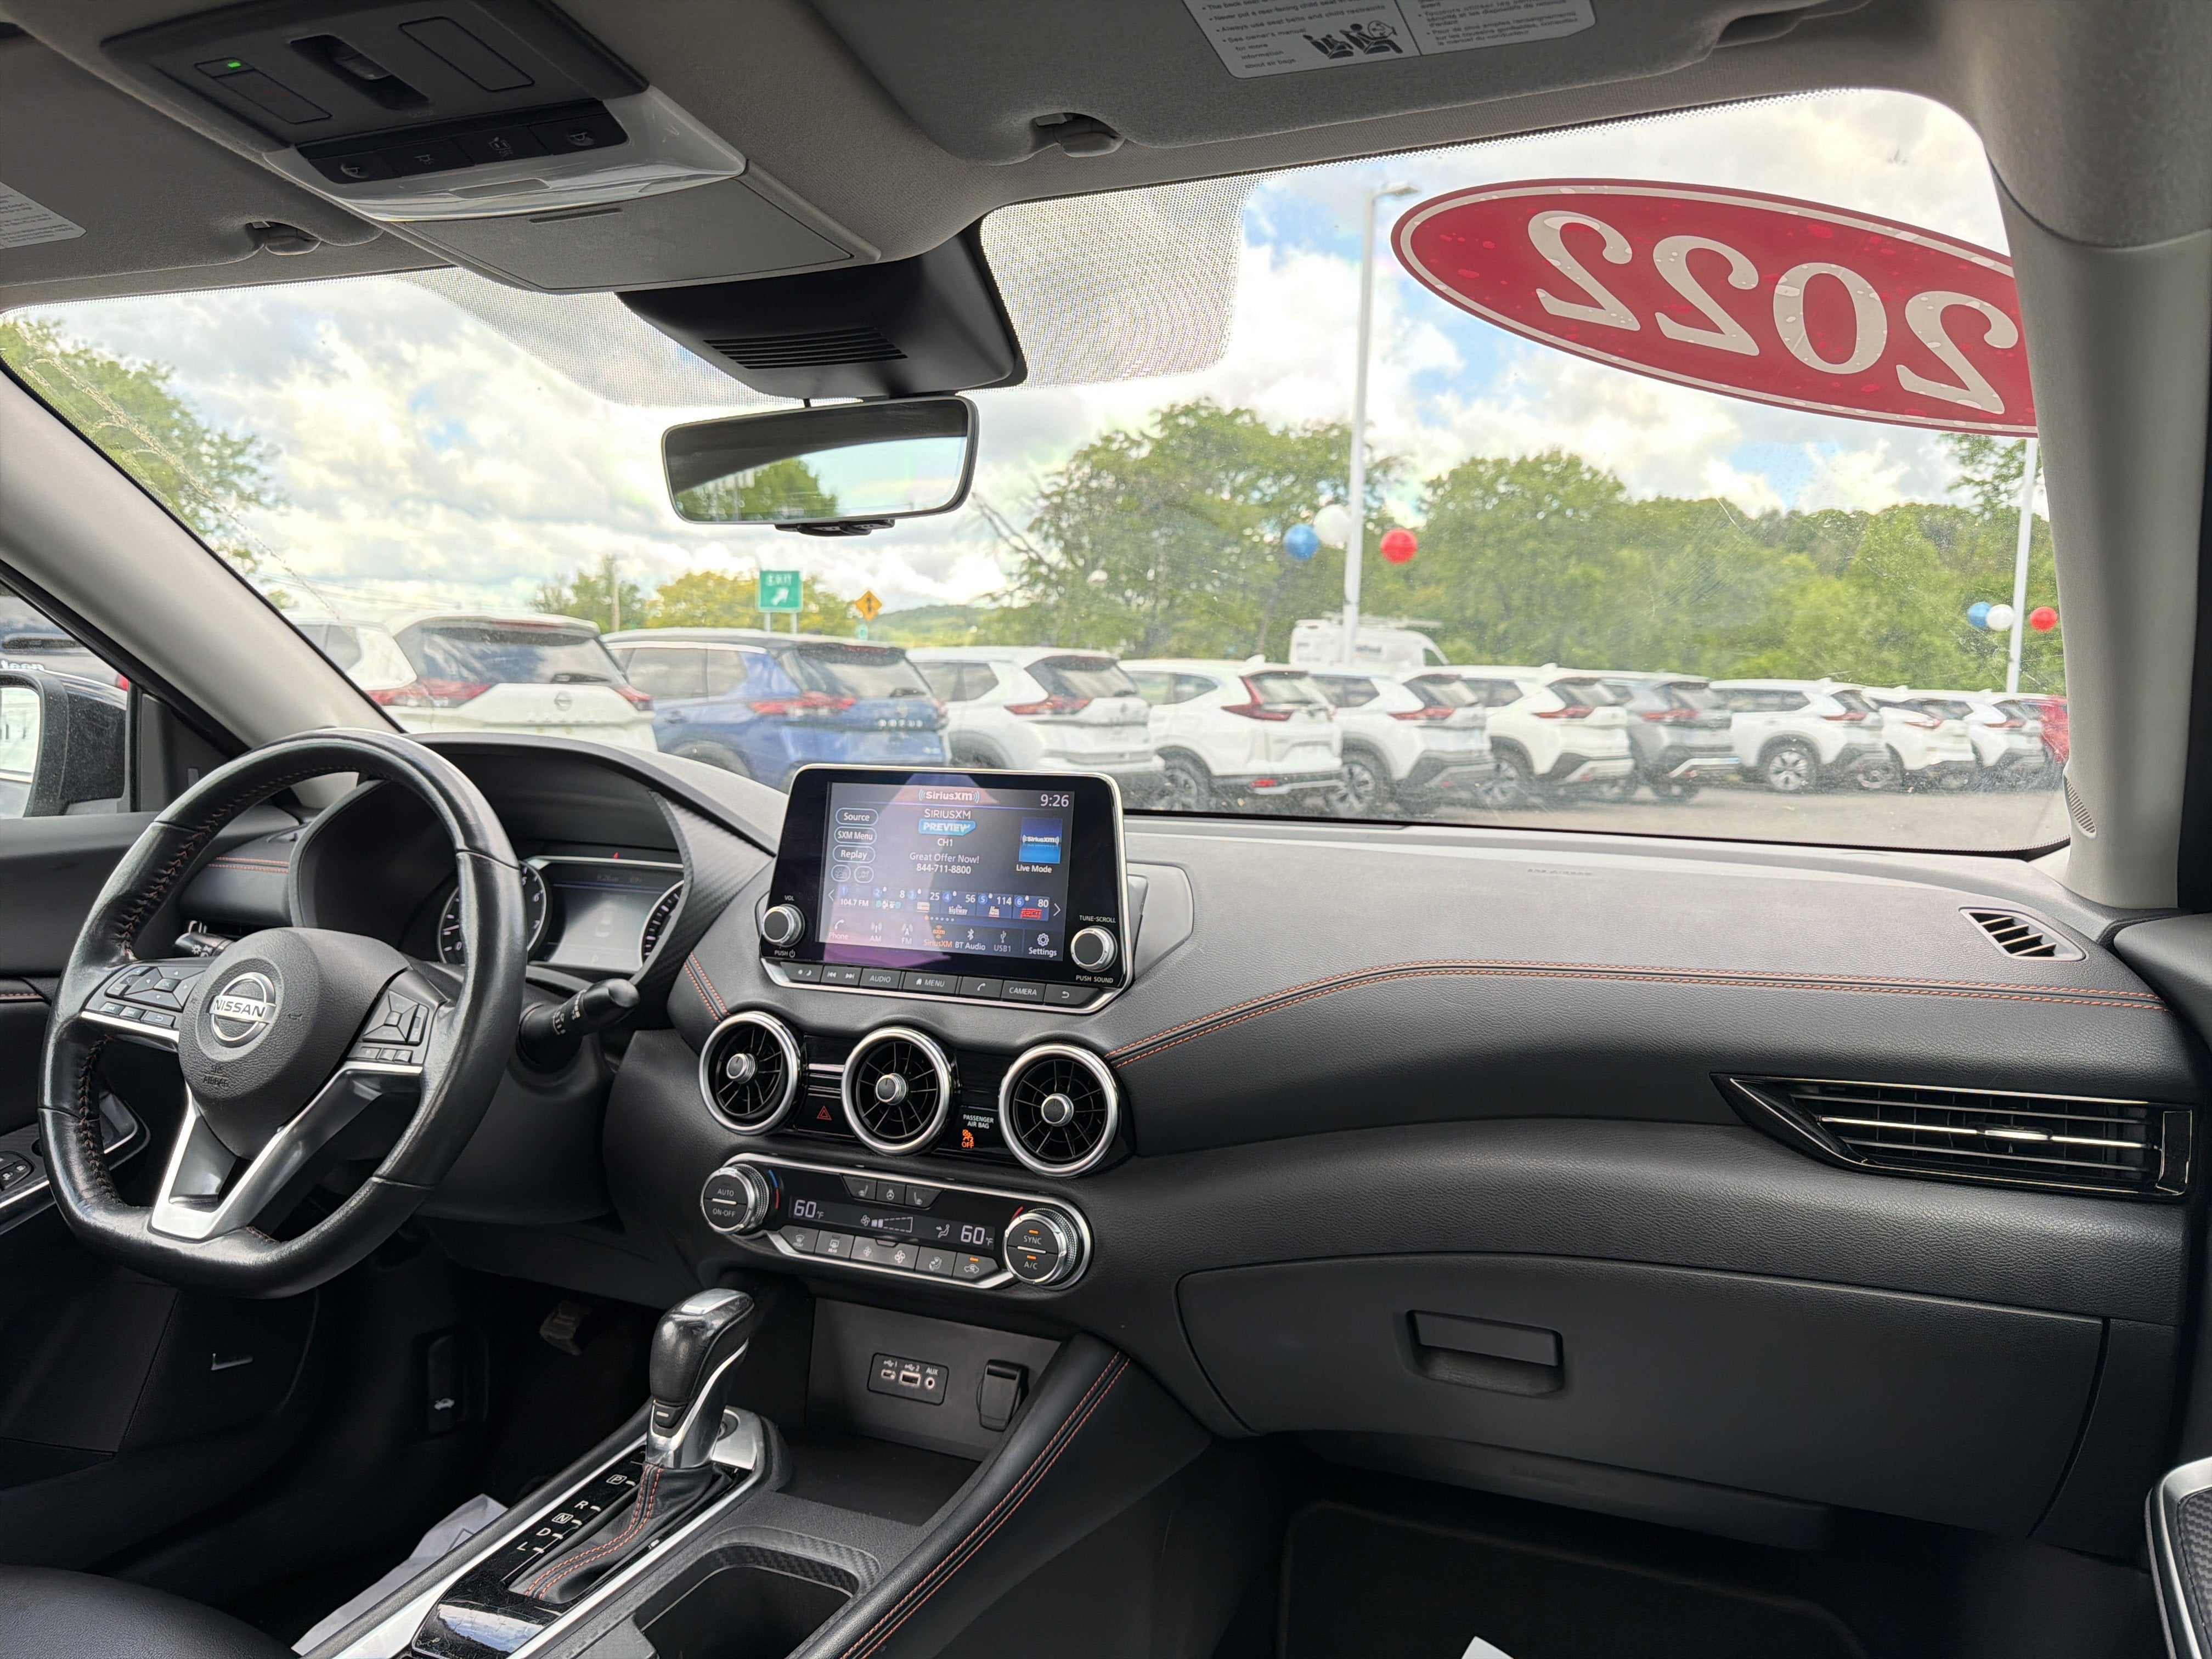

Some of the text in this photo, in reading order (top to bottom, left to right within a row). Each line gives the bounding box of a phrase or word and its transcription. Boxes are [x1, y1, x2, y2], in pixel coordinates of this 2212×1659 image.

[1222, 24, 1249, 32] Always
[1245, 32, 1276, 41] owner's
[1278, 27, 1307, 36] manual
[1241, 50, 1284, 60] information
[1040, 794, 1069, 807] 9:26
[843, 812, 870, 822] Source
[924, 809, 972, 820] SIRIUSXM
[923, 822, 971, 833] PREVIEW
[837, 831, 873, 840] SXM Menu
[937, 838, 953, 847] CH1
[840, 850, 867, 860] Replay
[910, 853, 979, 864] Great Offer Now!
[916, 864, 972, 874] 844-711-8800
[1016, 864, 1052, 873] Live Mode
[533, 893, 540, 902] 6
[900, 890, 905, 899] 8
[930, 892, 940, 901] 25
[965, 894, 976, 903] 56
[997, 896, 1012, 905] 114
[1037, 899, 1049, 907] 80
[533, 920, 540, 929] 7
[828, 932, 849, 940] Phone
[455, 941, 462, 951] 0
[923, 939, 952, 947] SiriusXM
[964, 942, 986, 950] Audio
[1028, 947, 1057, 957] Settings
[870, 975, 891, 983] AUDIO
[924, 979, 945, 987] MENU
[1009, 986, 1037, 996] CAMERA
[213, 999, 266, 1018] NISSAN
[963, 1114, 994, 1124] PASSENGER
[717, 1188, 734, 1197] AUTO
[1023, 1235, 1042, 1245] SYNC
[1024, 1261, 1037, 1270] A/C
[926, 1367, 939, 1376] AUX
[574, 1500, 589, 1509] R
[537, 1527, 551, 1536] D
[517, 1542, 528, 1551] L
